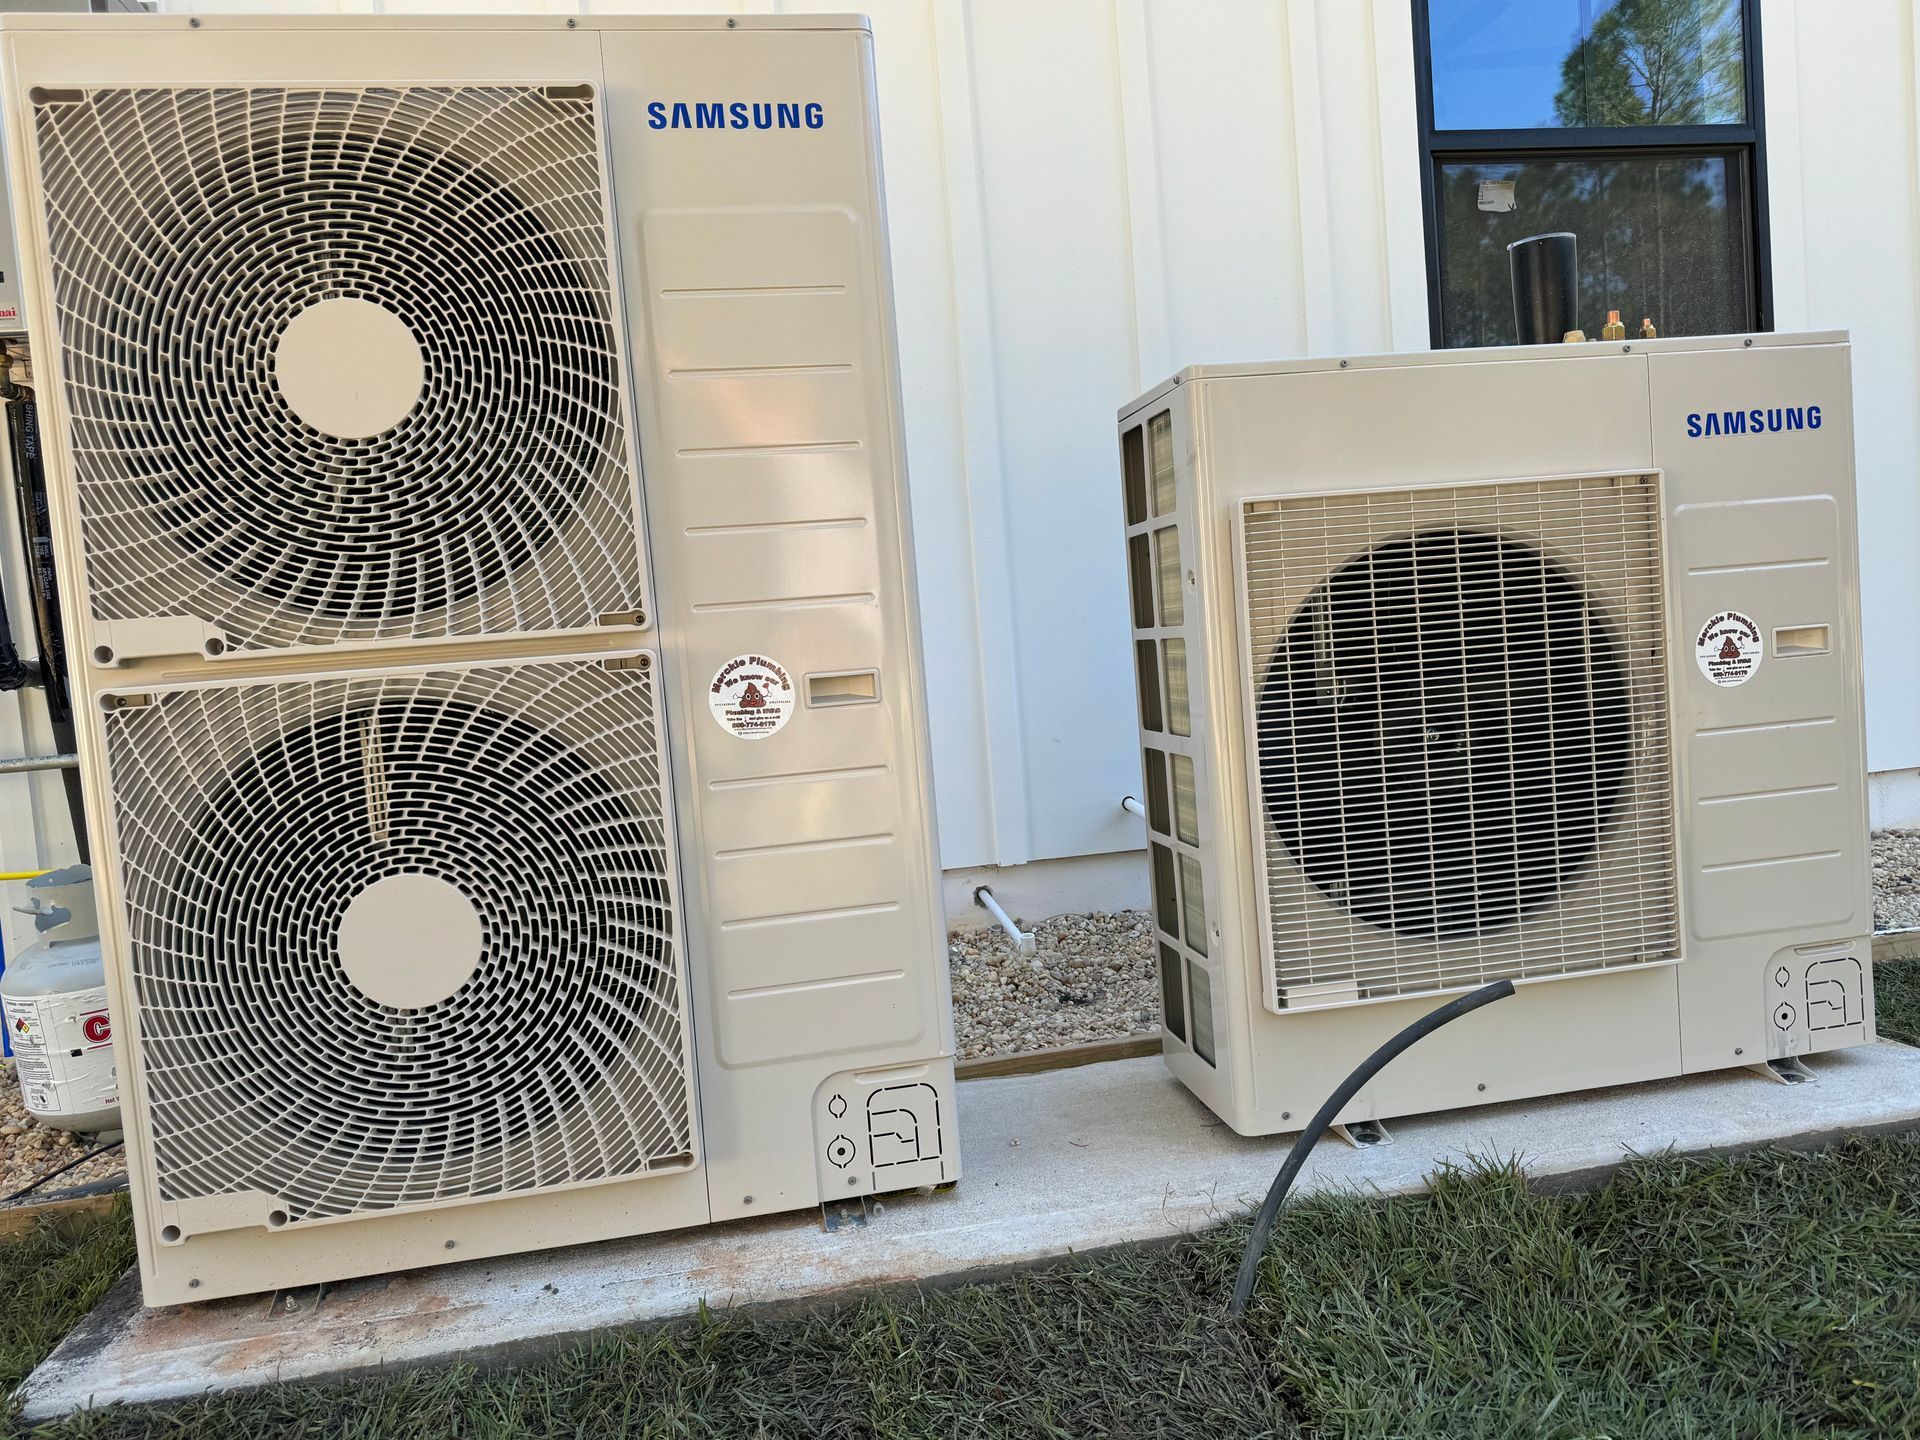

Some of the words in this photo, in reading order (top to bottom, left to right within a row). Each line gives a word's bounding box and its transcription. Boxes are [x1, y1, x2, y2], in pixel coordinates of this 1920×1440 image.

[647, 102, 823, 129] SAMSUNG
[1687, 406, 1822, 437] SAMSUNG
[25, 434, 36, 459] TAPE
[1720, 628, 1738, 636] know
[1739, 630, 1751, 638] our
[1728, 613, 1760, 643] Plumbing
[739, 674, 763, 682] know
[765, 676, 780, 686] our
[749, 656, 791, 691] Plumbing
